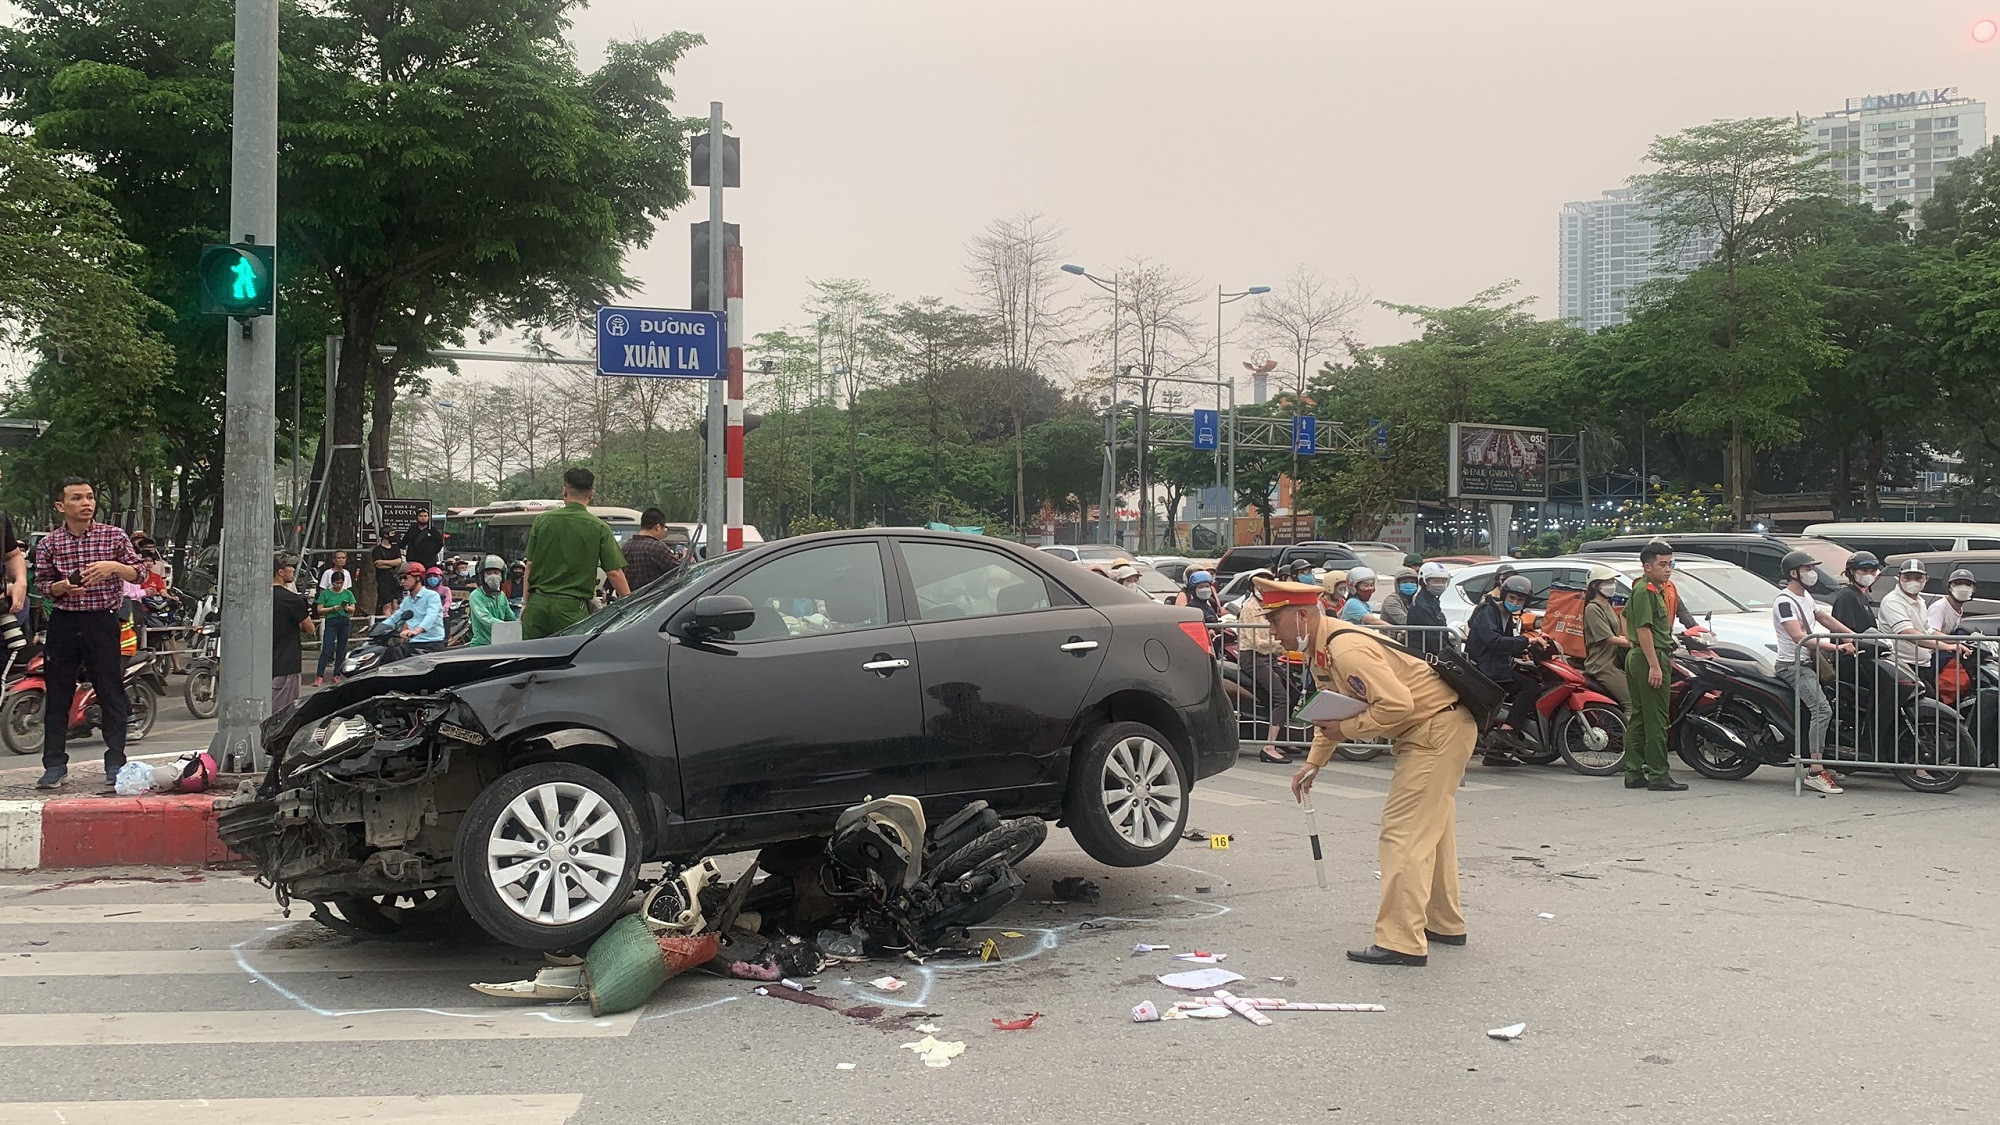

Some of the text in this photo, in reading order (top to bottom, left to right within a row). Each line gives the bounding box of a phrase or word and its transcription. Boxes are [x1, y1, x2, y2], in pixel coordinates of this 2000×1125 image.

[640, 316, 706, 336] ĐƯỜNG
[623, 340, 700, 370] XUÂN LA
[1489, 469, 1514, 477] GARDEN
[1214, 837, 1227, 846] 16
